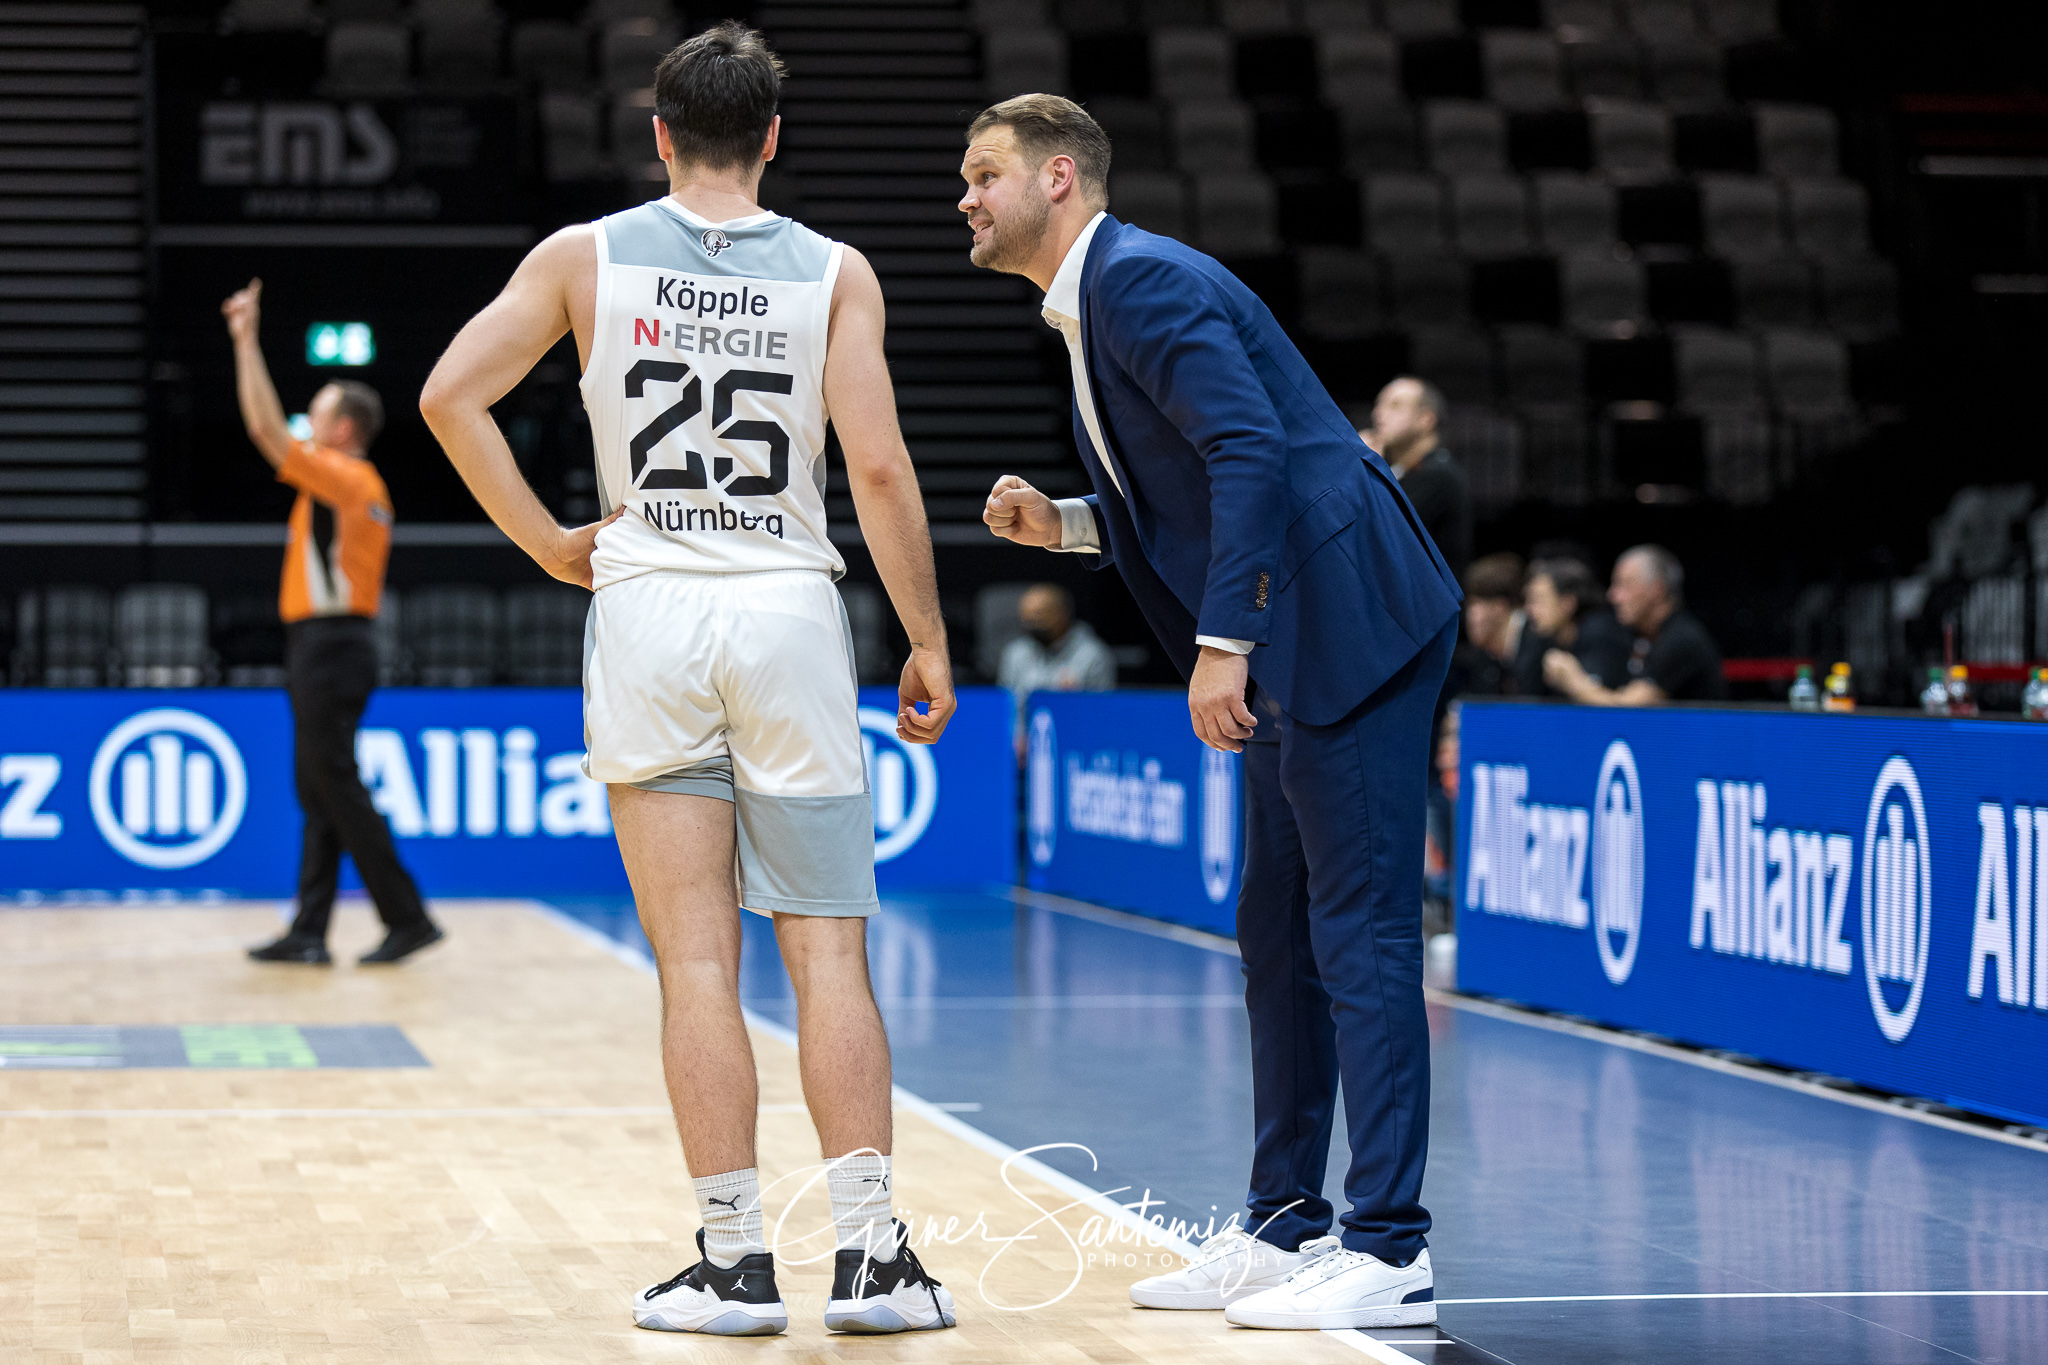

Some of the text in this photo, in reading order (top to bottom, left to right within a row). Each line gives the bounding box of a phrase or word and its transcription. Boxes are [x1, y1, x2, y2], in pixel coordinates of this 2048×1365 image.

[656, 277, 769, 320] Köpple
[625, 359, 794, 497] 25
[644, 501, 784, 540] Nürnberg
[1465, 761, 1591, 930] Allianz
[1689, 778, 1854, 976] Allianz
